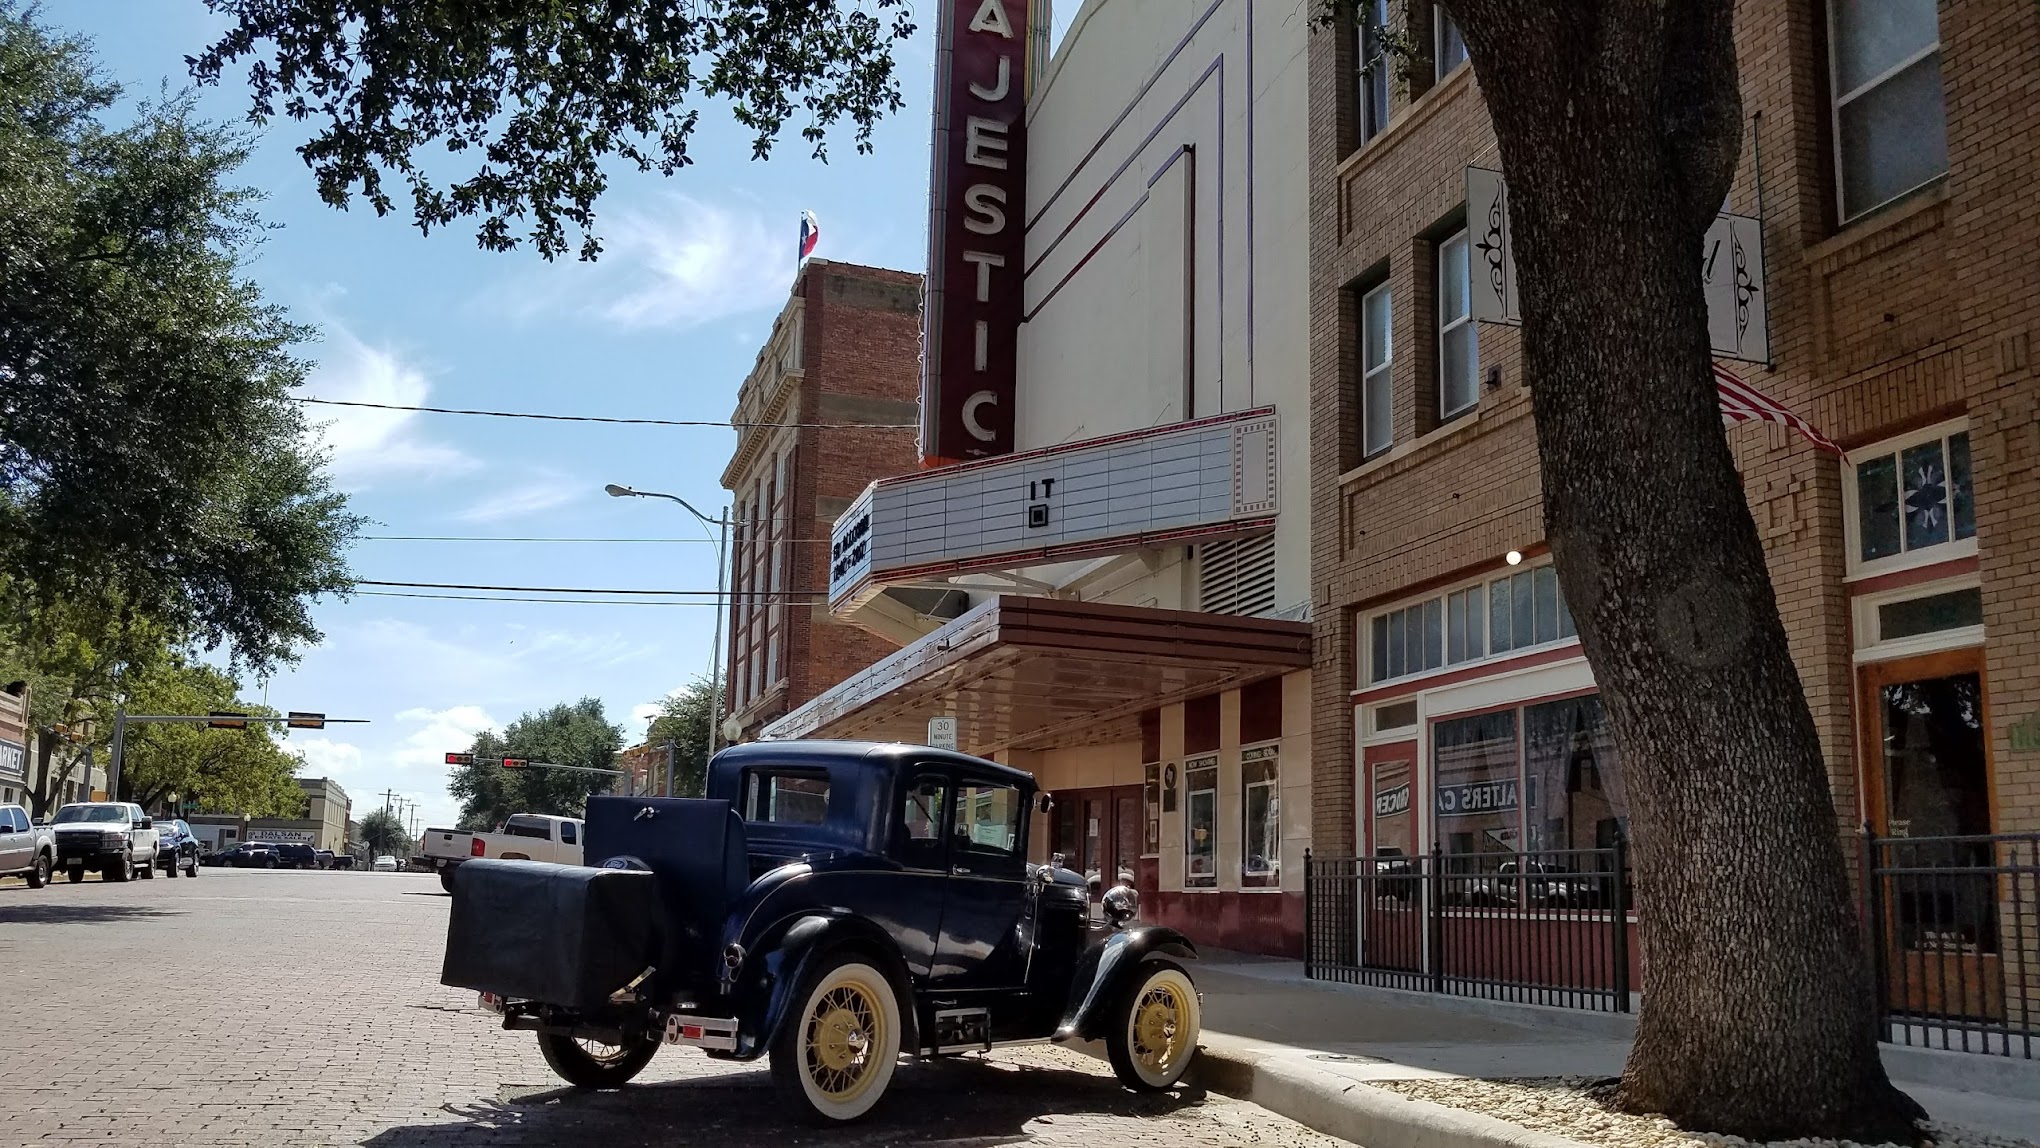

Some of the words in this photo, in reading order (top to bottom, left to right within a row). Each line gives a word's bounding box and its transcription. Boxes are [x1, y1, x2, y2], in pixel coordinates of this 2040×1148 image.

[1030, 478, 1055, 500] IT
[937, 721, 950, 731] 30
[1891, 827, 1909, 838] Ring
